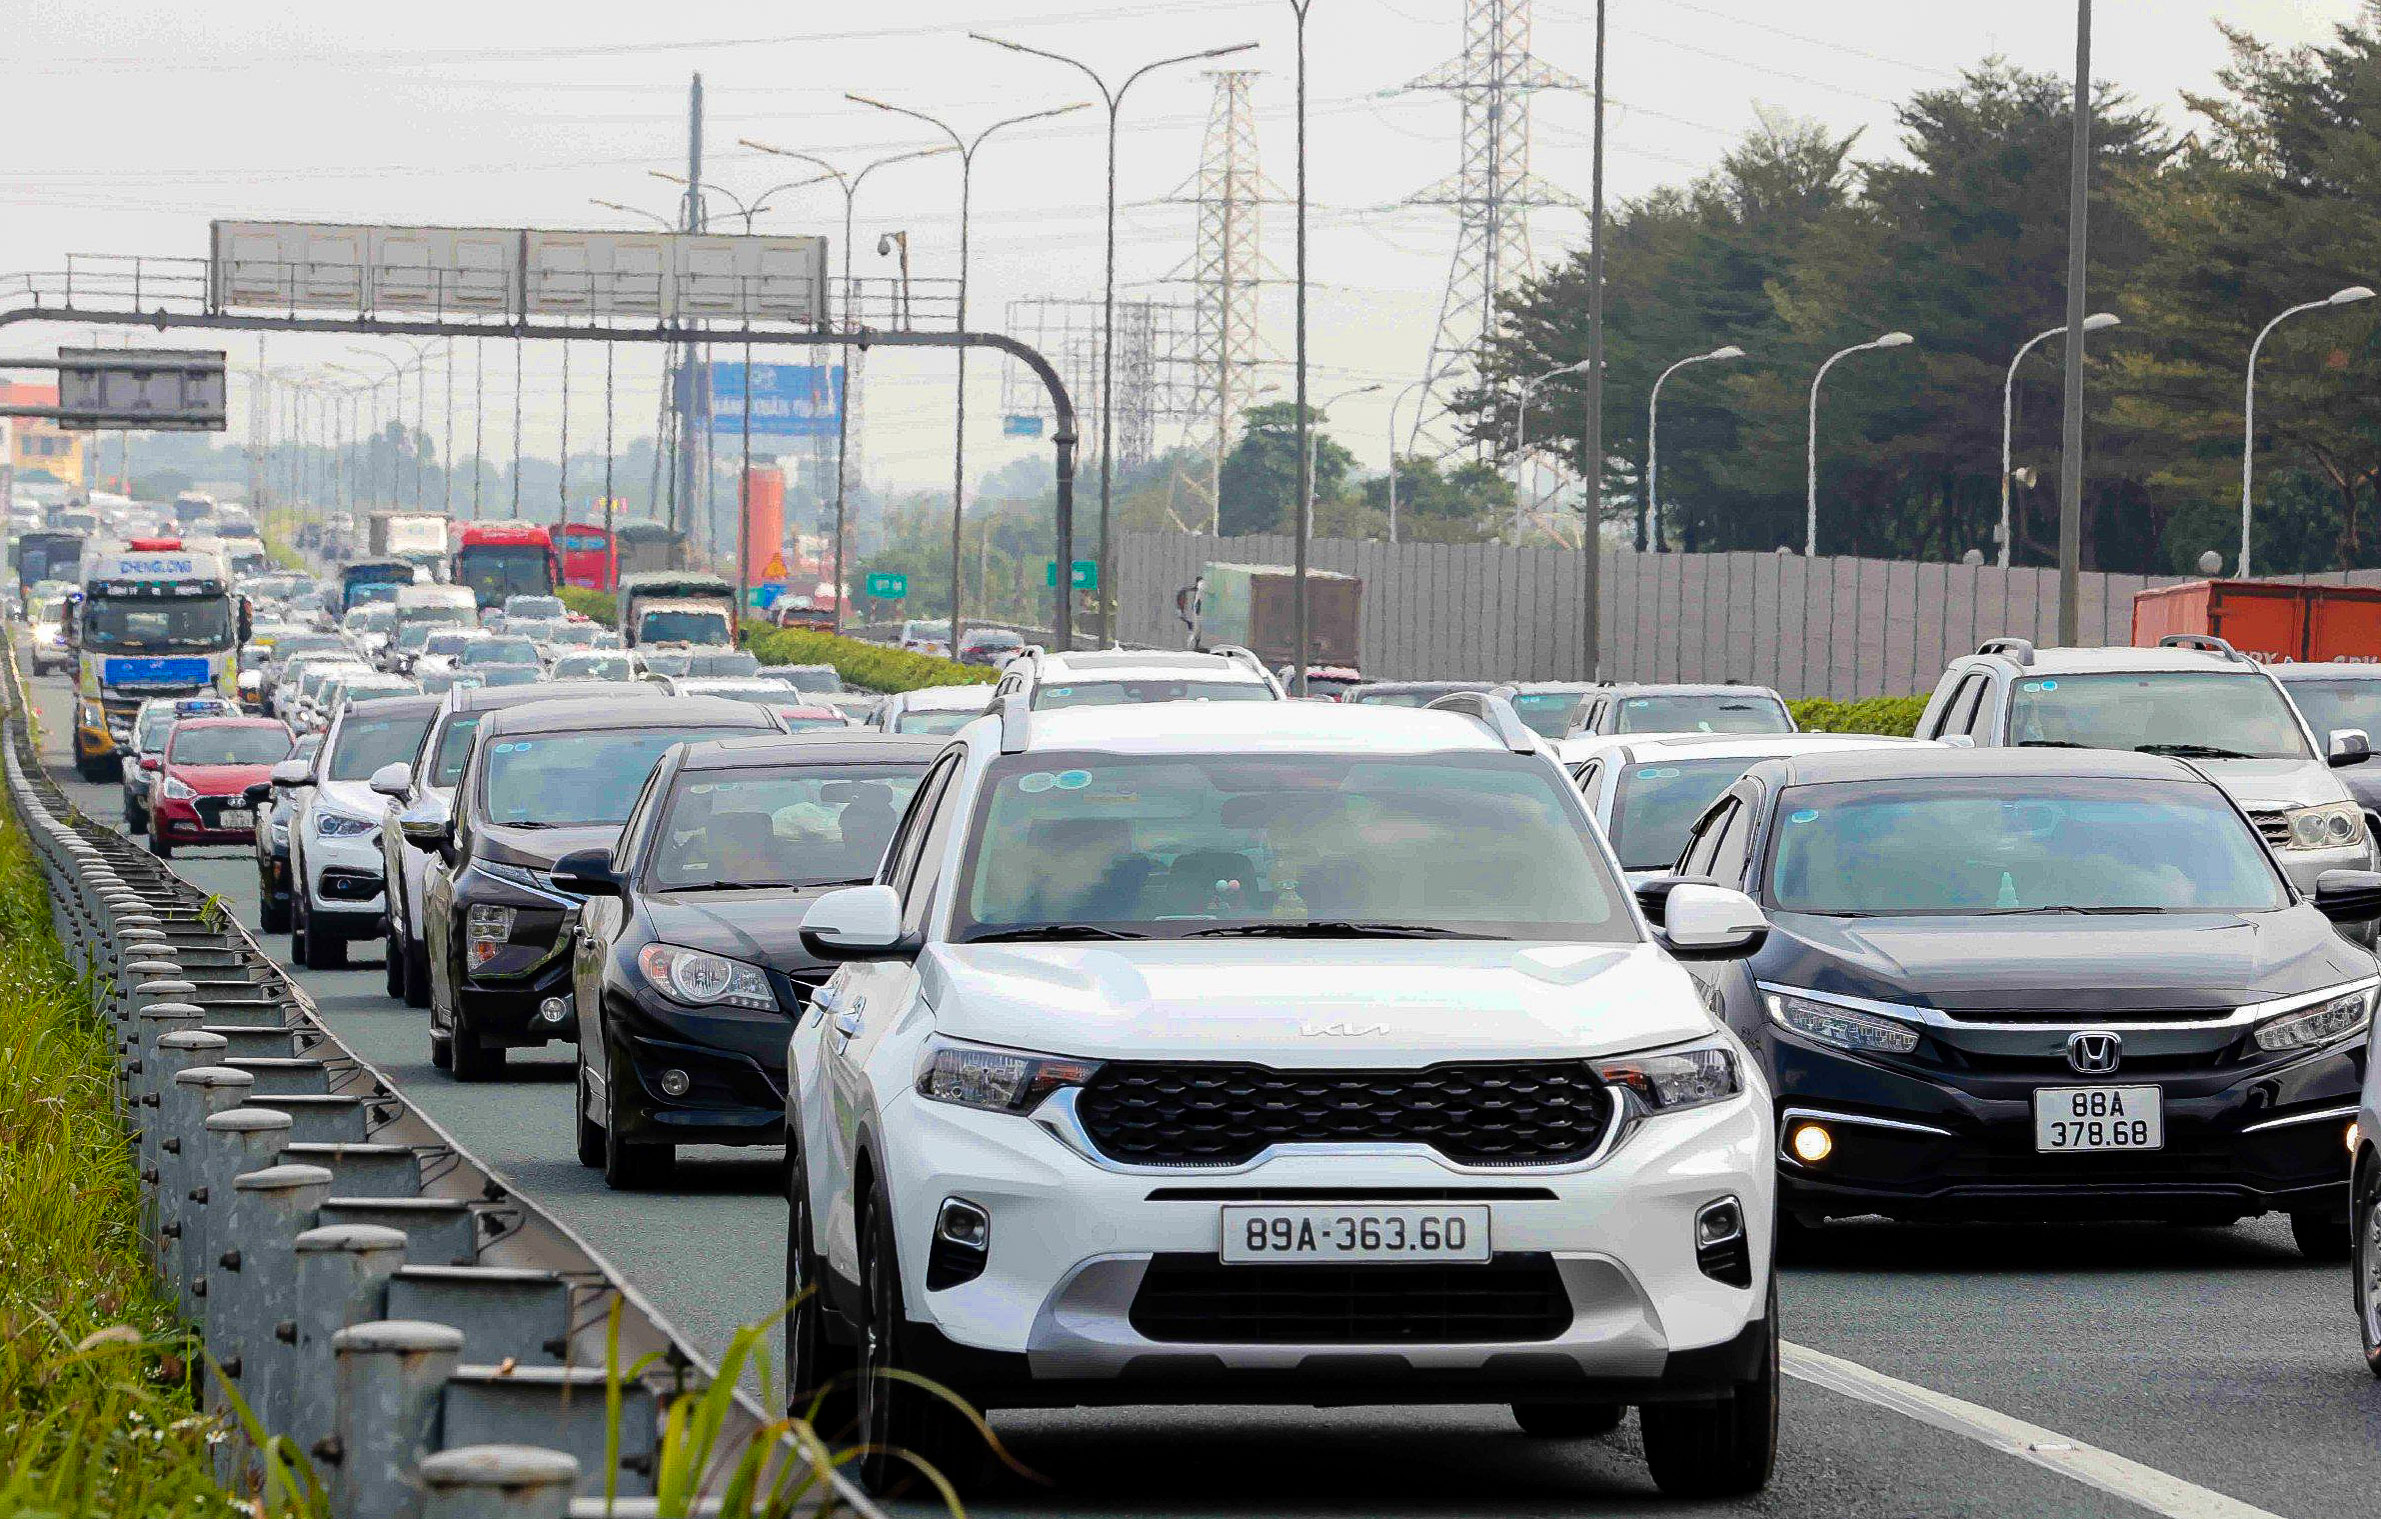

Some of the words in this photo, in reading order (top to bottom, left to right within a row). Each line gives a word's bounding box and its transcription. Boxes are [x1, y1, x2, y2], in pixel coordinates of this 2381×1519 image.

[2072, 1090, 2125, 1117] 88A
[2050, 1120, 2148, 1147] 378.68
[1246, 1216, 1467, 1252] 89A-363.60
